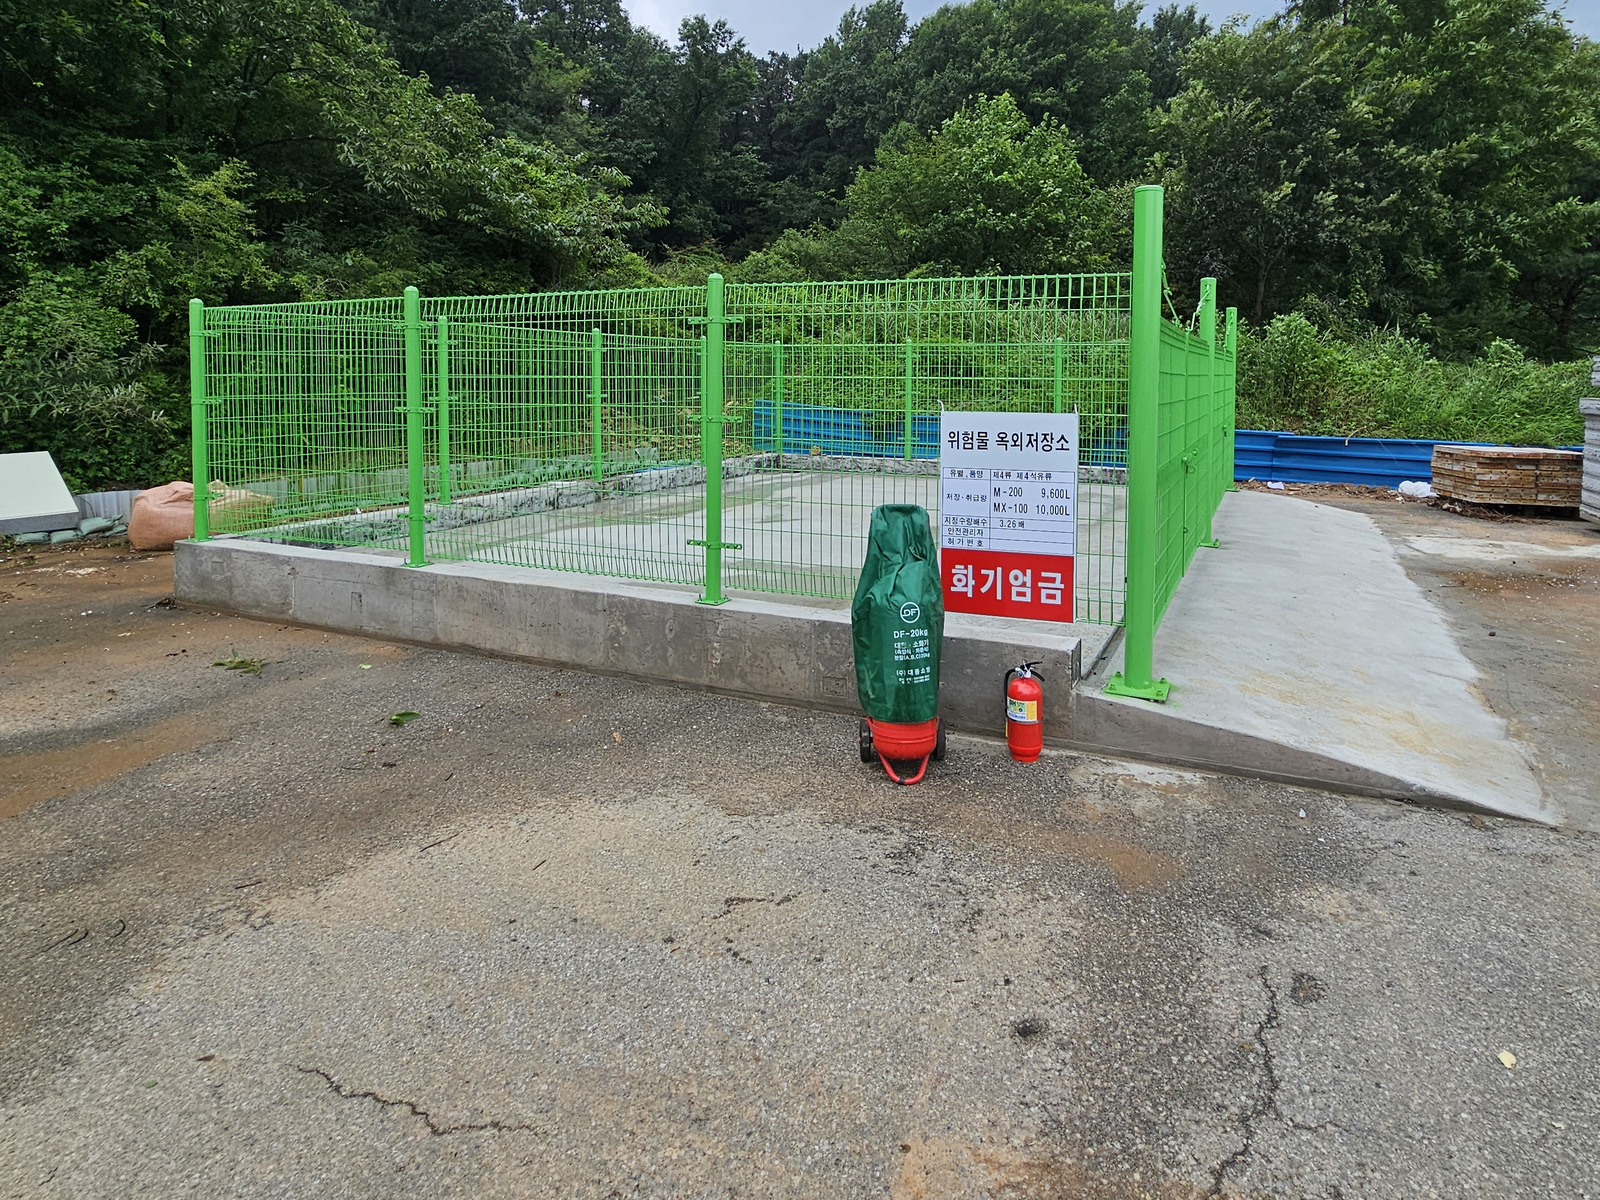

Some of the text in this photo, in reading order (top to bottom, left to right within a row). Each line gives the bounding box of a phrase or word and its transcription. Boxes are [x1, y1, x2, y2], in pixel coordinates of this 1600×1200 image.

[947, 431, 1070, 452] 위험물 옥외저장소
[993, 471, 1052, 481] 제4류 제4석유류
[1041, 487, 1071, 500] 9,600L
[993, 503, 1071, 516] MX-100 10,000L
[944, 516, 988, 526] 지정수량배수
[947, 527, 984, 537] 안전관리자
[950, 564, 1066, 605] 화기엄금
[893, 629, 929, 639] DF-20kg
